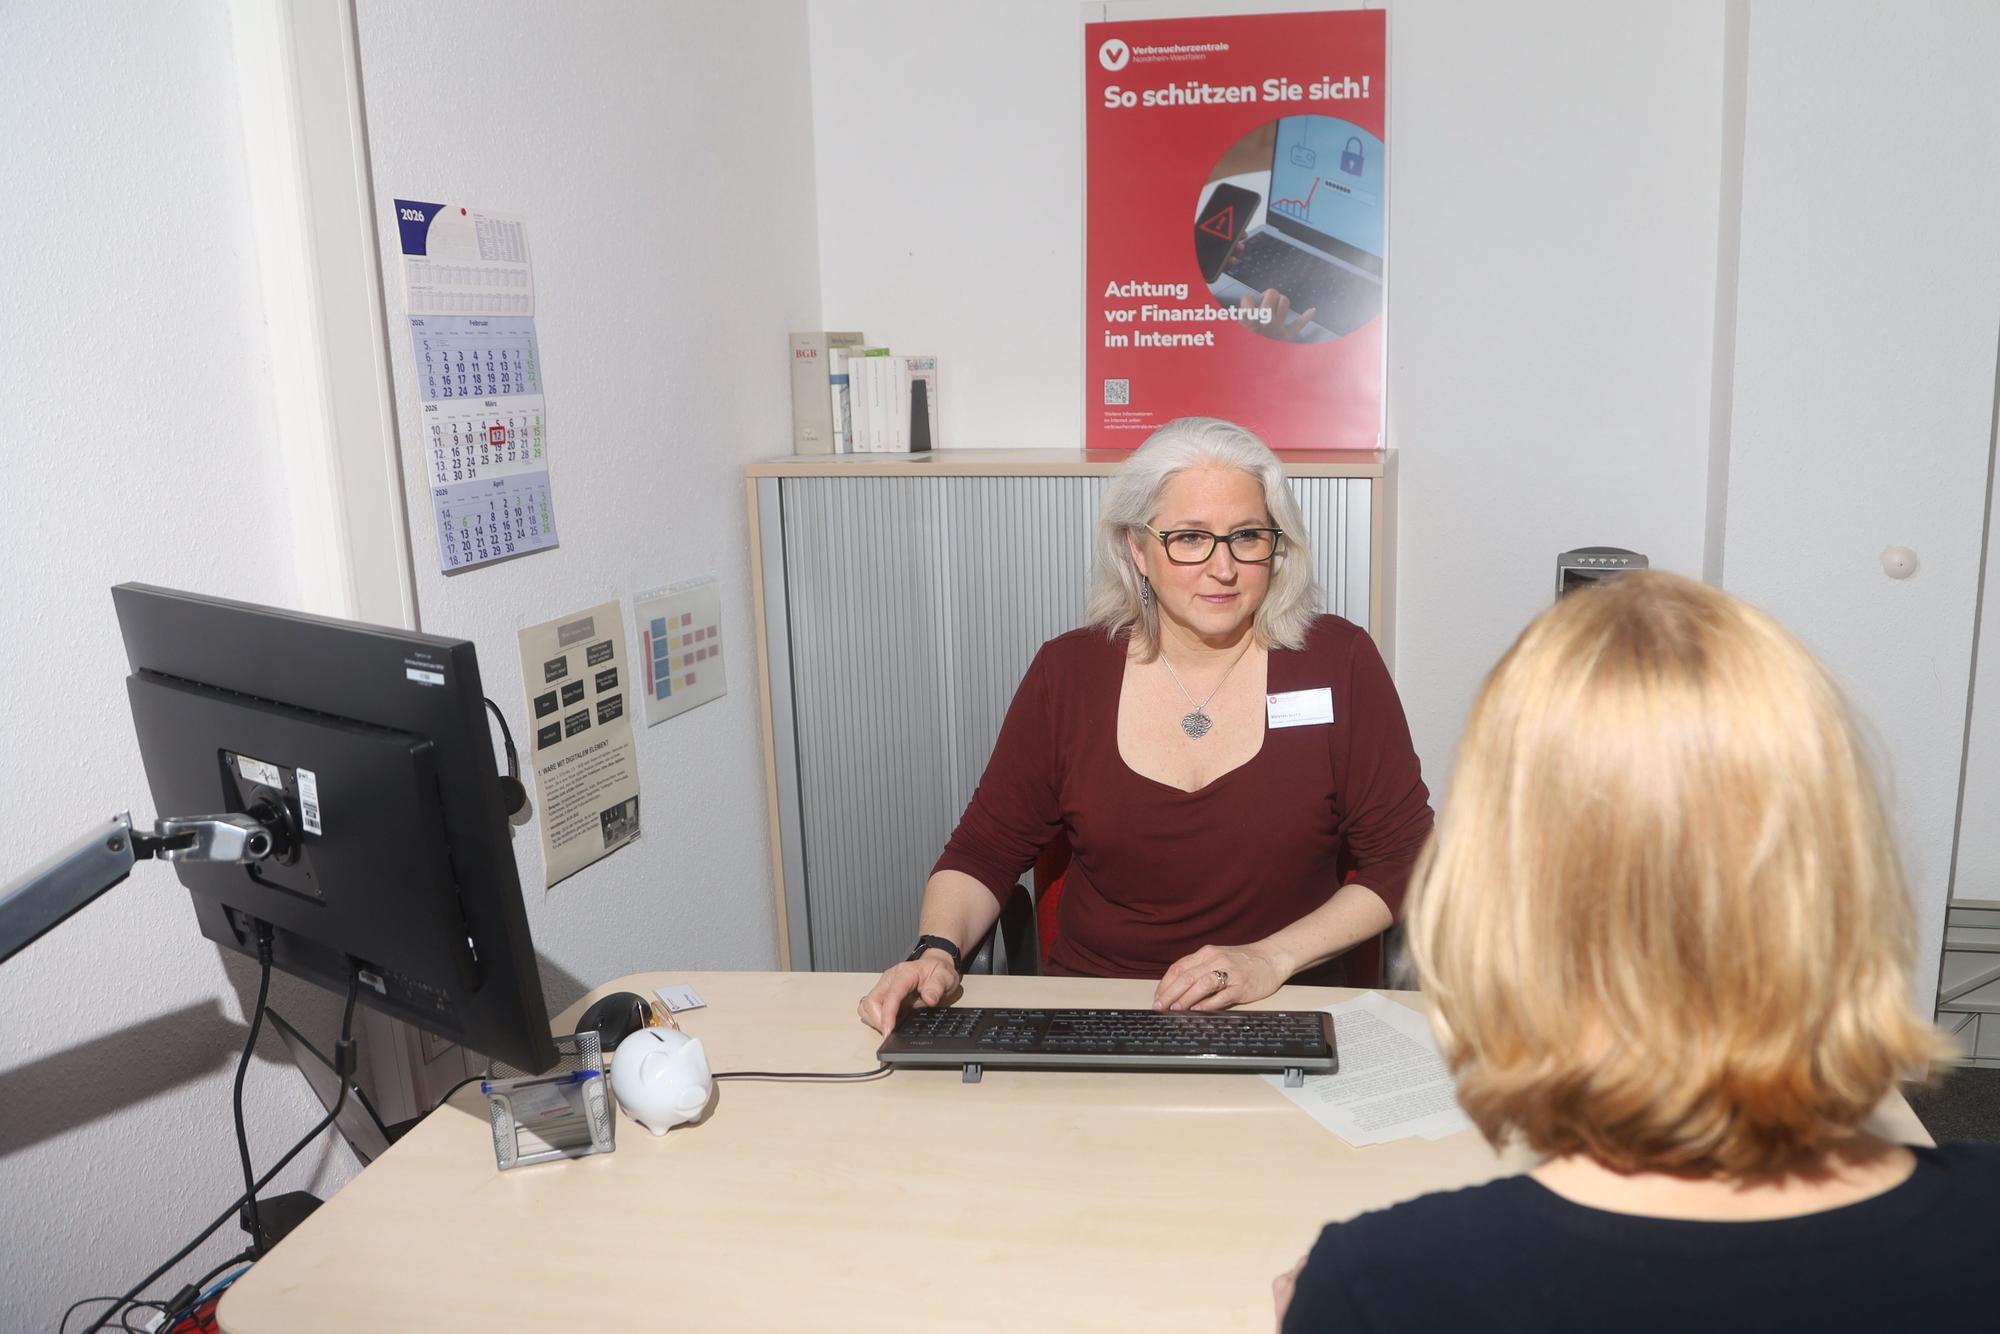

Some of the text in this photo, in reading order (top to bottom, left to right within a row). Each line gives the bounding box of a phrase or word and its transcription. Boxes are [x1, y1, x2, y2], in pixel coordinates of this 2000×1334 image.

[1132, 42, 1230, 54] Verbraucherzentrale
[1133, 53, 1206, 62] Nordrhein-Westfalen
[1104, 75, 1370, 108] So schützen Sie sich!
[400, 208, 424, 222] 2026
[1104, 280, 1189, 300] Achtung
[1104, 304, 1272, 324] vor Finanzbetrug
[1104, 330, 1214, 348] im Internet
[796, 349, 817, 358] BGB
[542, 763, 558, 774] WARE
[566, 748, 588, 764] DIGITALEM
[590, 740, 608, 754] ELEMENT
